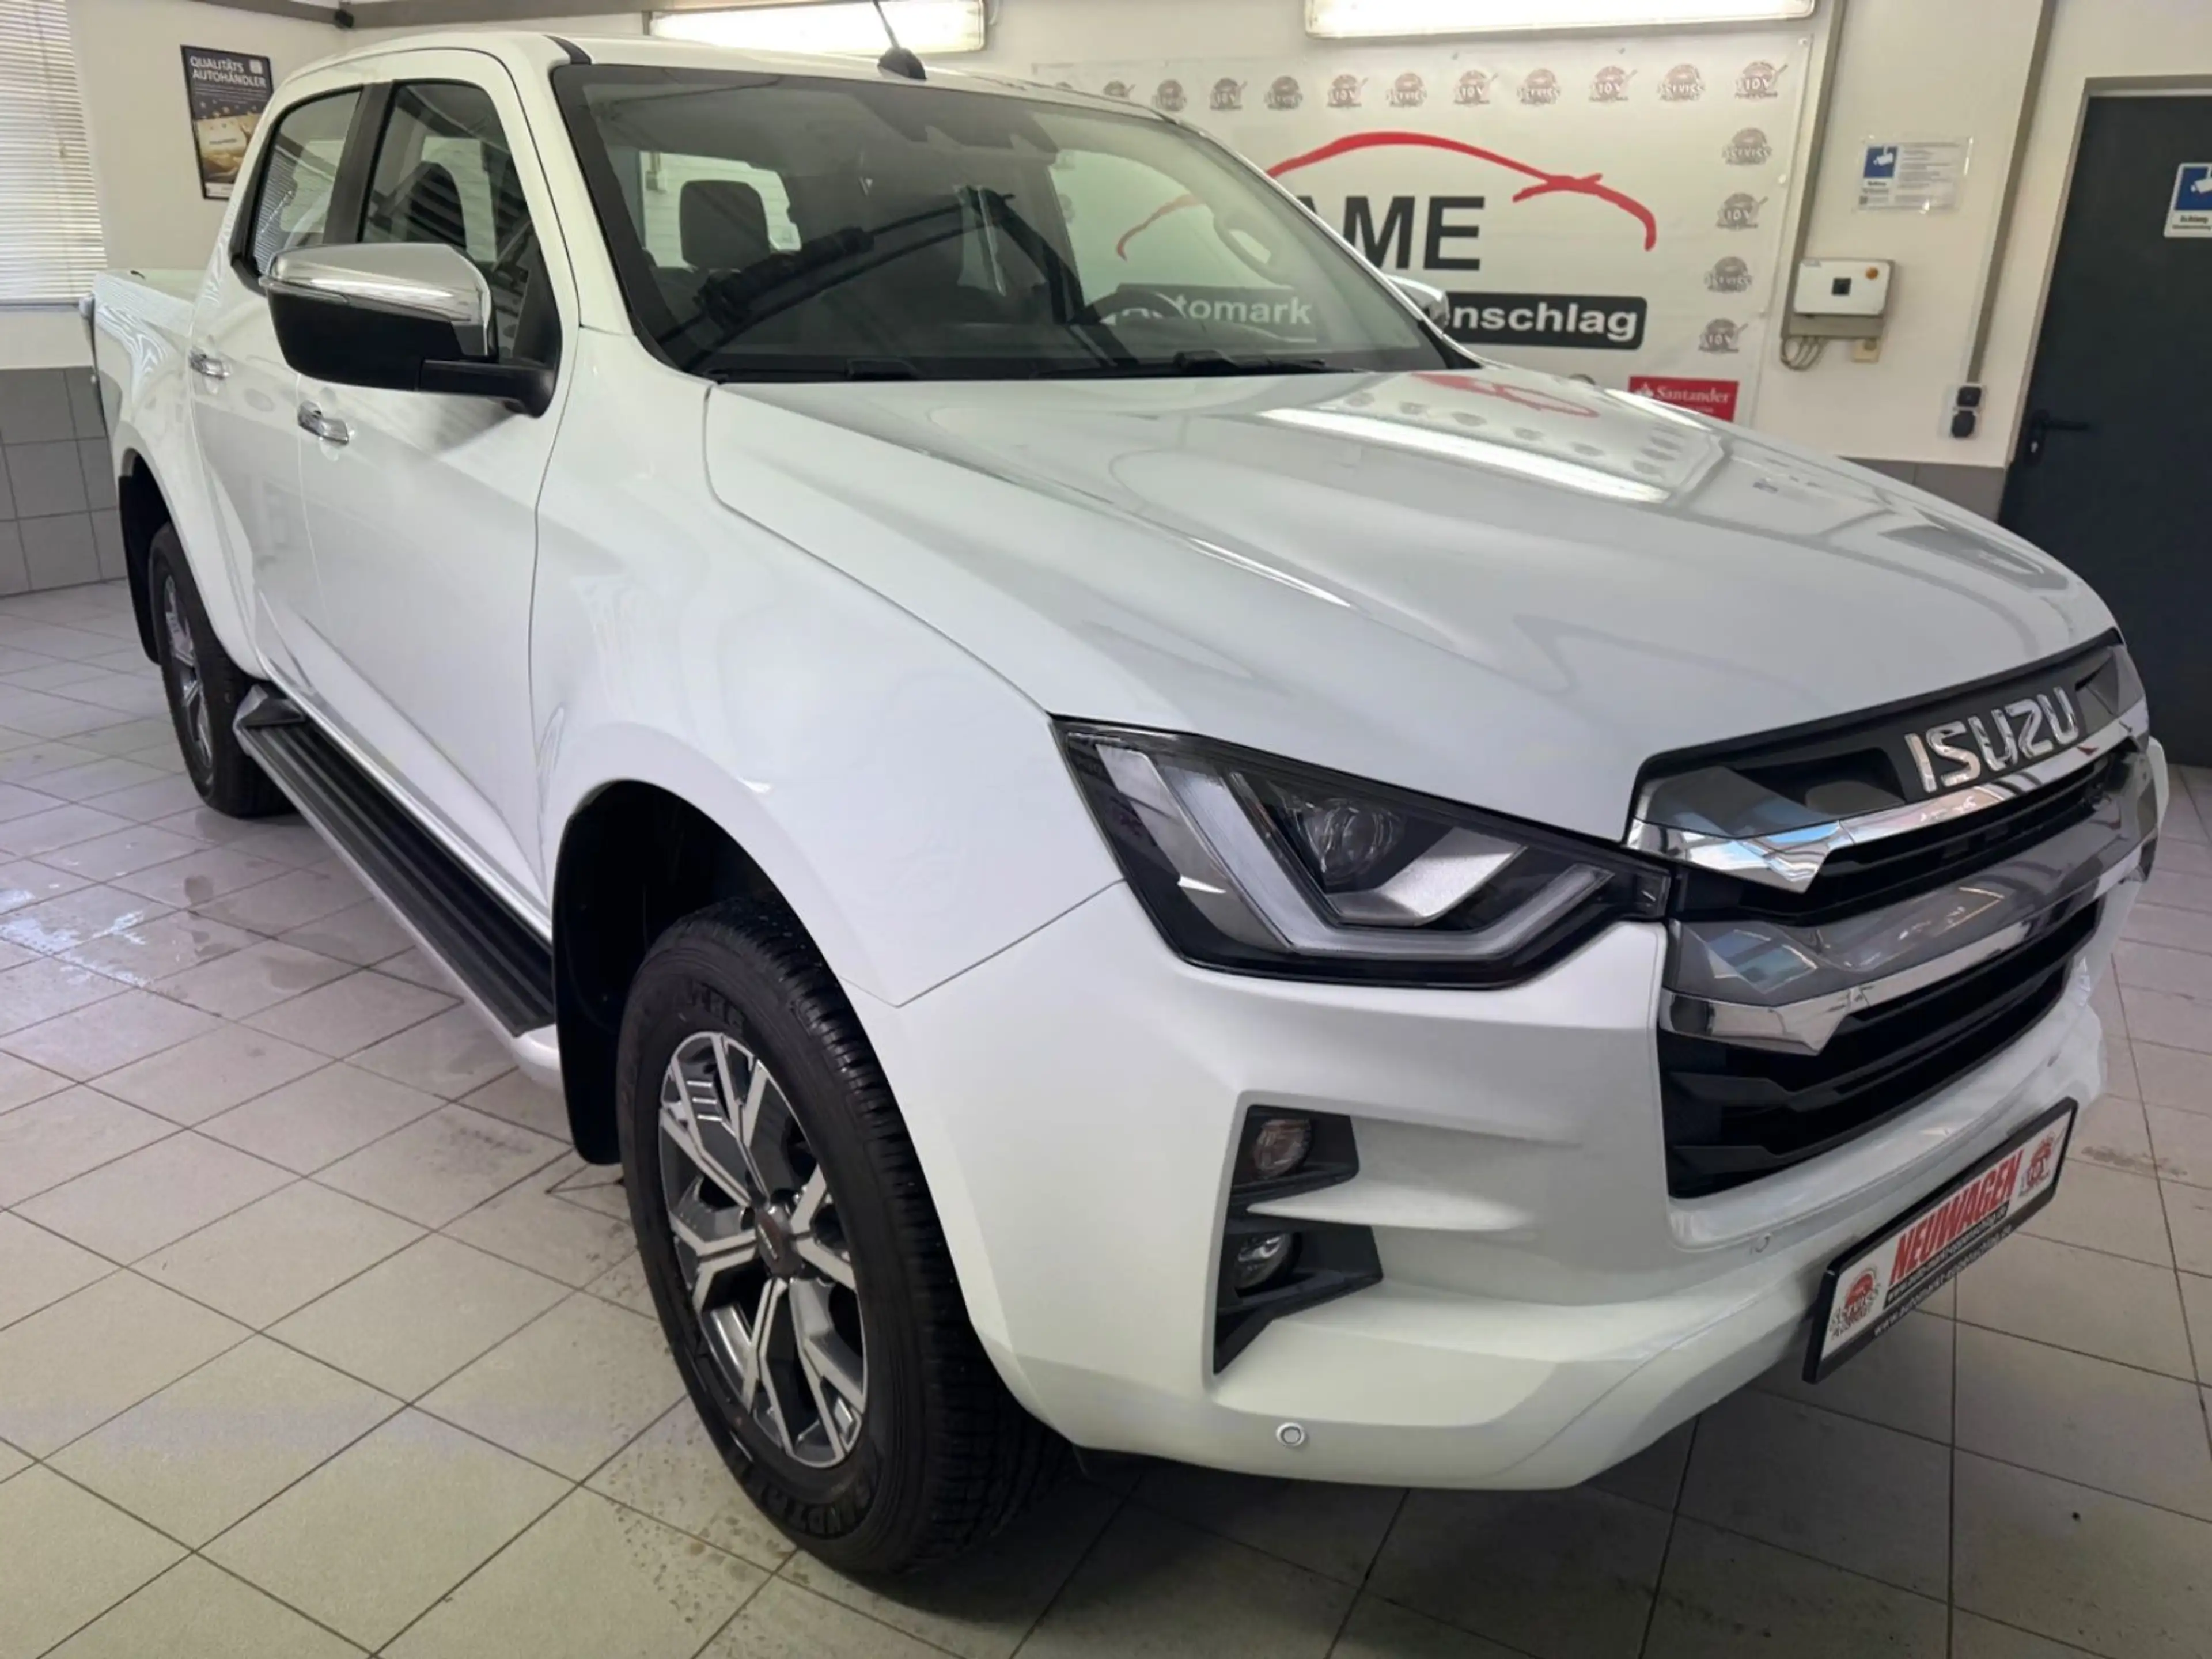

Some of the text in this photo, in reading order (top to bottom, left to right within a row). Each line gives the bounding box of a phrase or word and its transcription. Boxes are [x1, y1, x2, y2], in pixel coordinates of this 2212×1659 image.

[190, 56, 244, 73] QUALITÄTS
[192, 68, 266, 88] AUTOHÄNDLER
[1297, 196, 1485, 271] ME
[1657, 385, 1729, 403] Santander
[1904, 687, 2079, 793] ISUZU
[1888, 1148, 2024, 1289] NEUWAGEN
